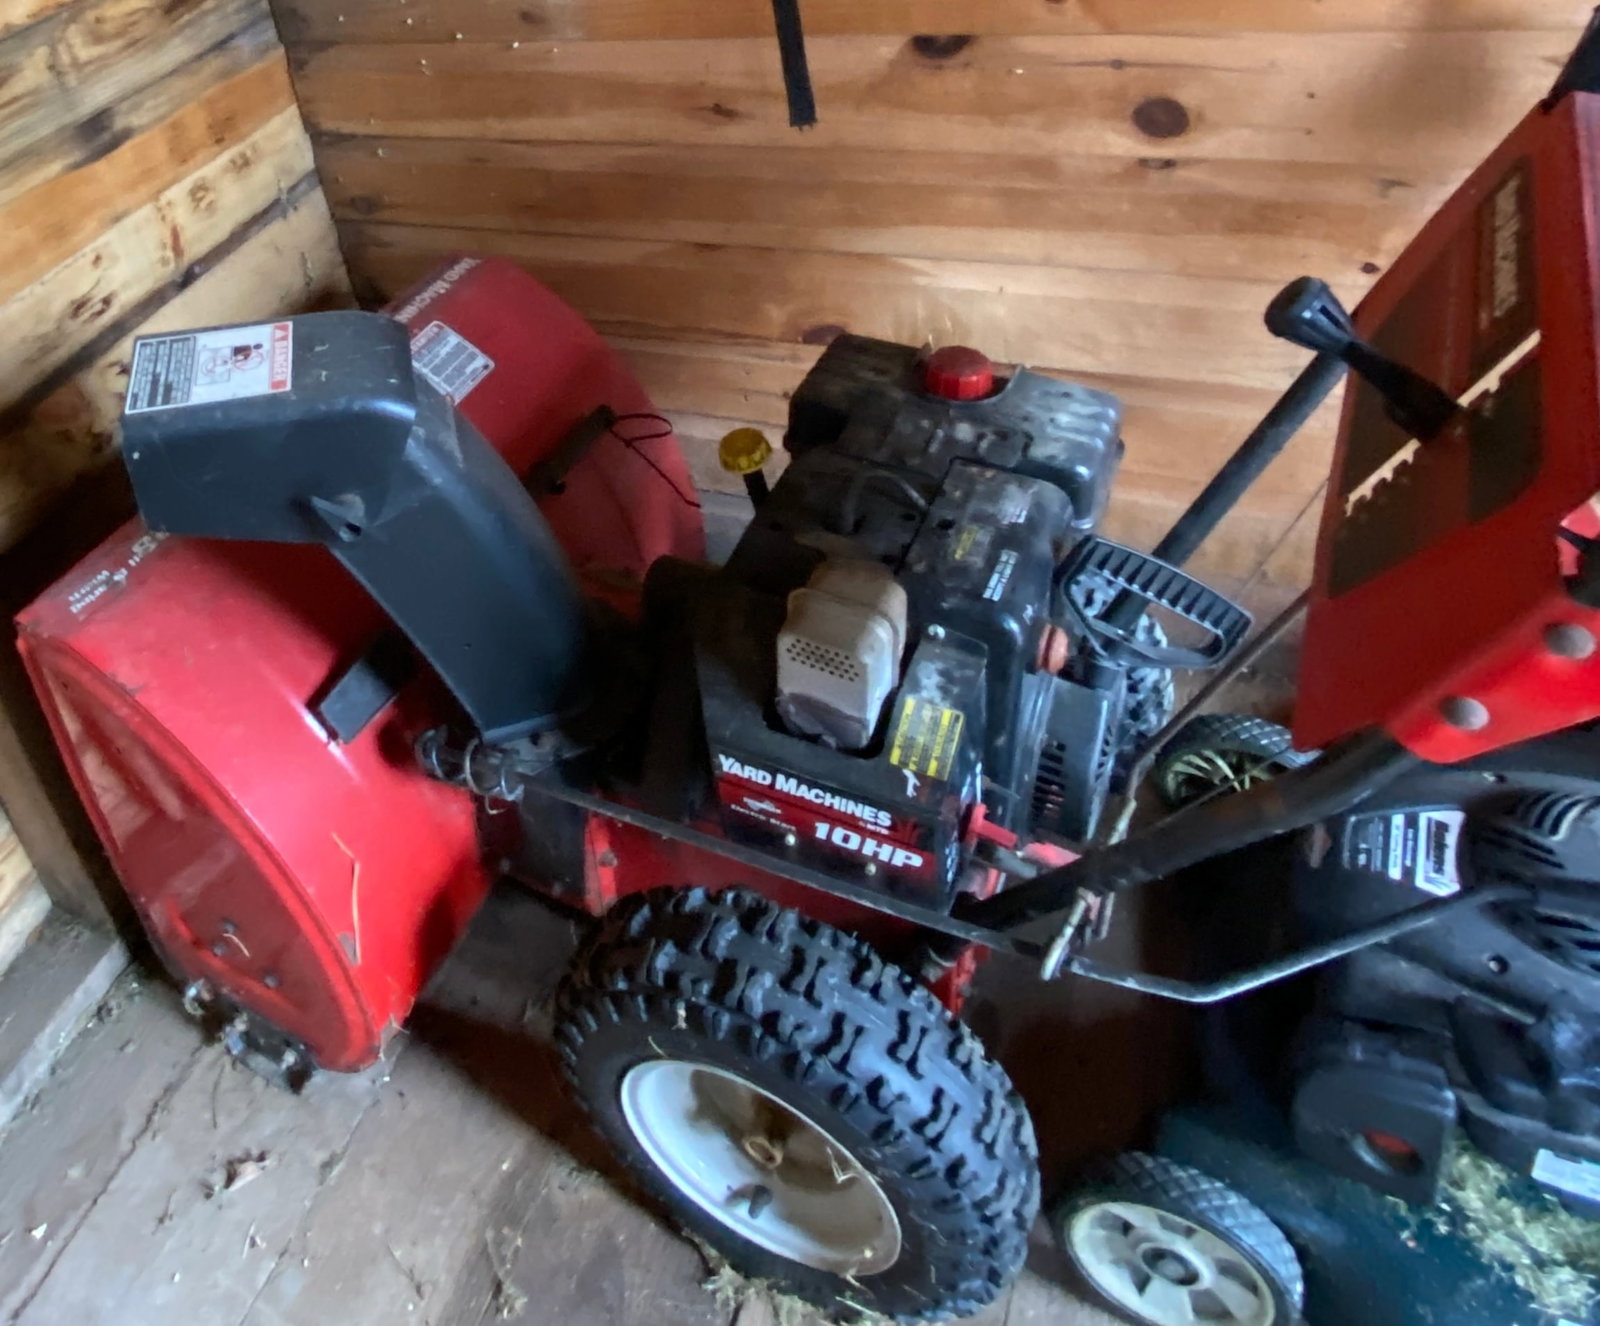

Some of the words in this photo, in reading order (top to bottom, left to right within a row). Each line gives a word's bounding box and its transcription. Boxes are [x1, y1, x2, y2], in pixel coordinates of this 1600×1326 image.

[272, 340, 290, 382] DANGER
[718, 754, 773, 785] YARD
[775, 773, 892, 826] MACHINES
[814, 821, 924, 868] 10HP
